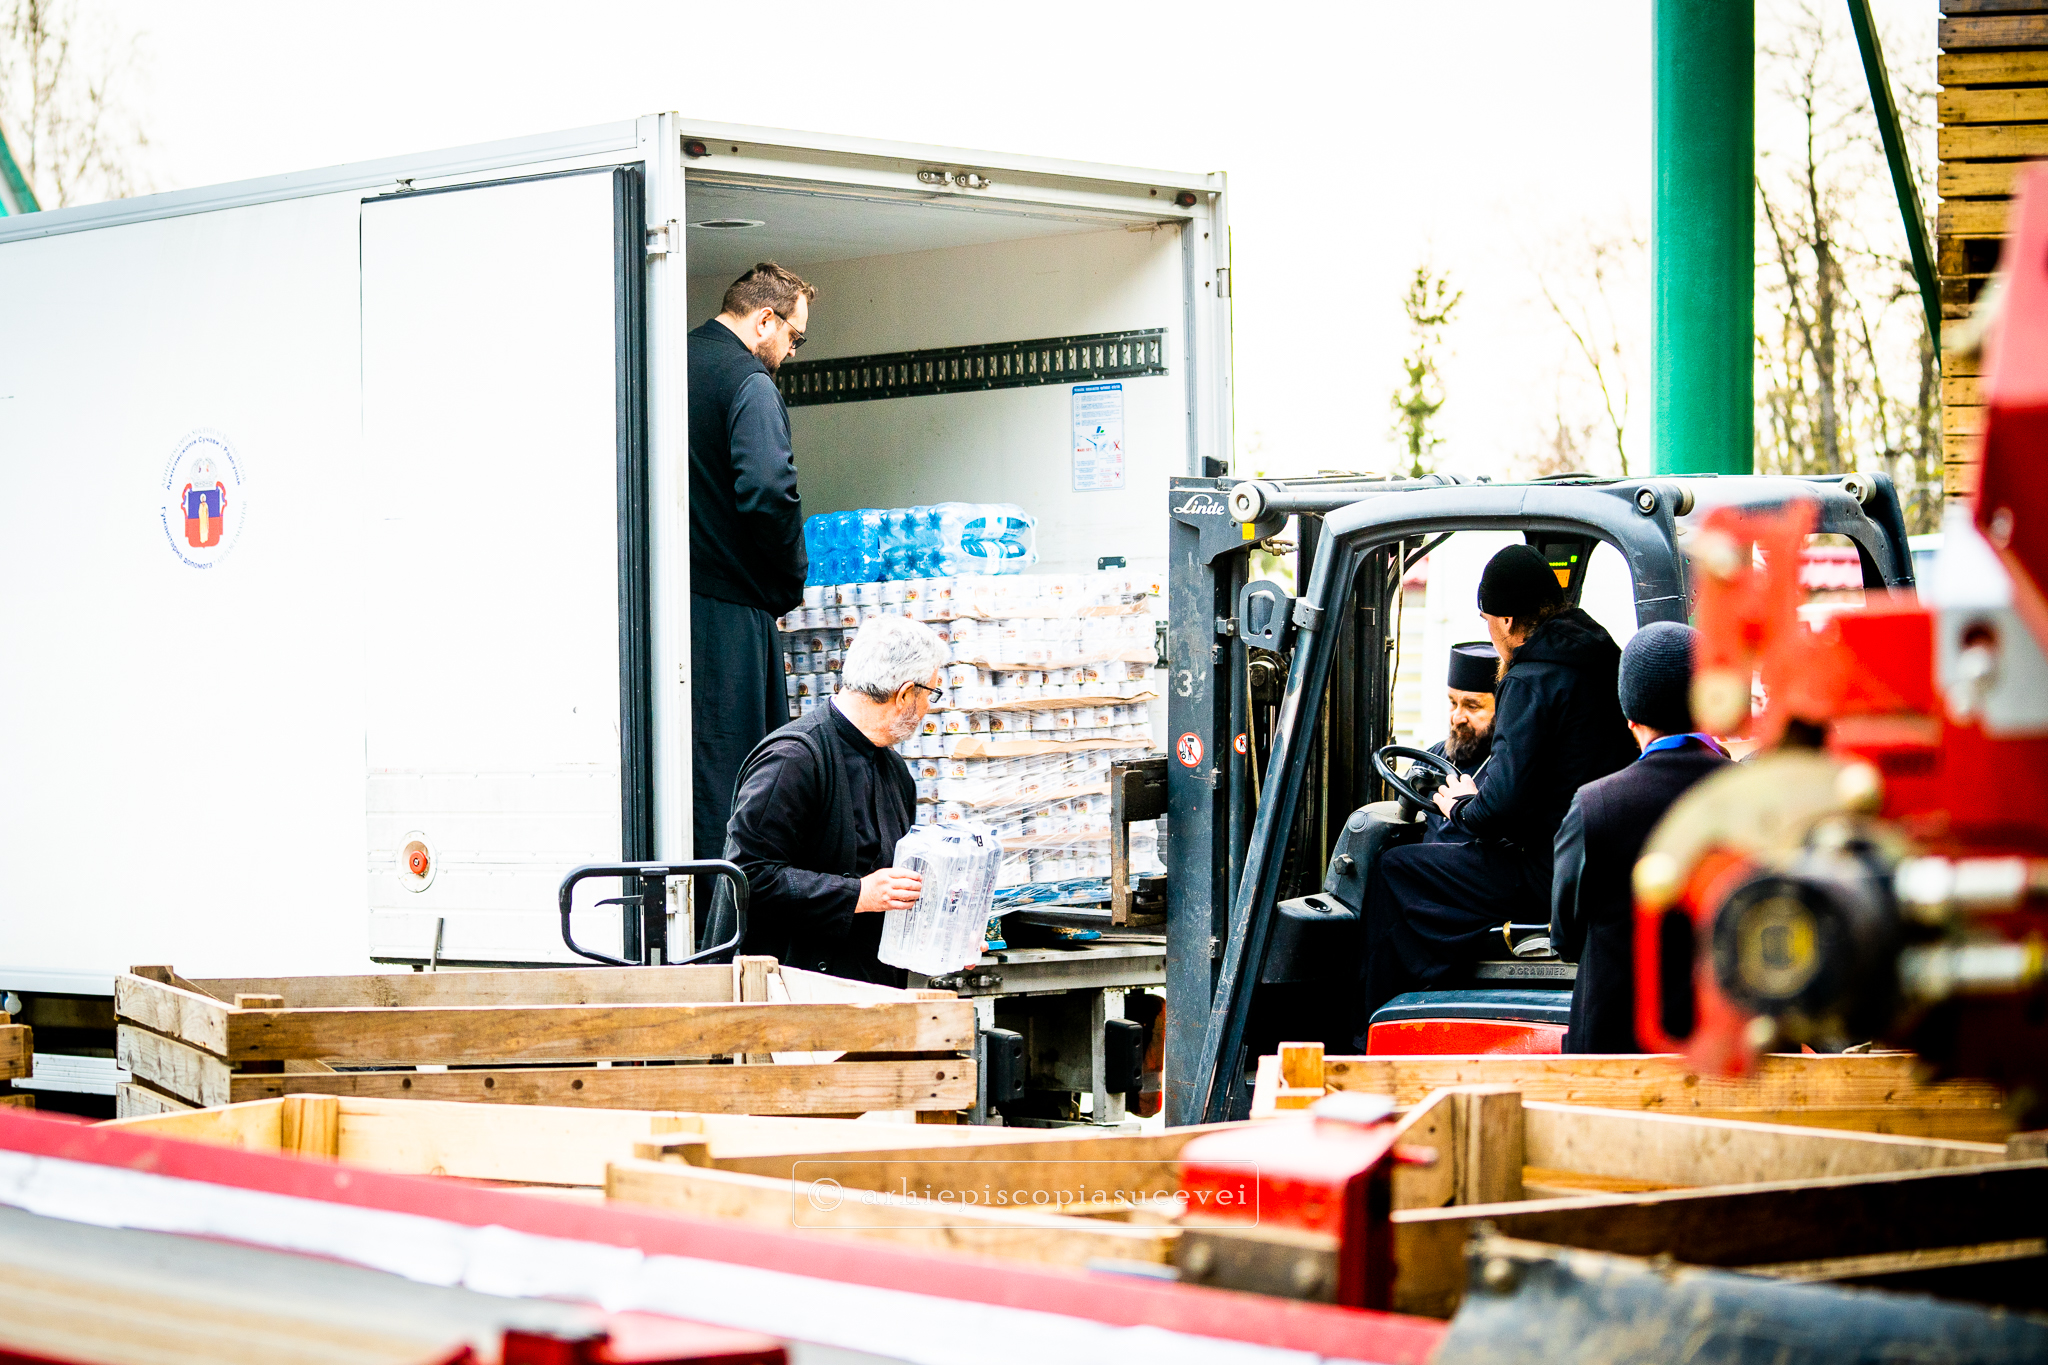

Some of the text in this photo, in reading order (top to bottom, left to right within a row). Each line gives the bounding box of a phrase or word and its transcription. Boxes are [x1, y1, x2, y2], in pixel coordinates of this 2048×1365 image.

[1173, 494, 1225, 516] Linde
[183, 557, 213, 570] допомога
[1517, 966, 1567, 976] GRAMMER
